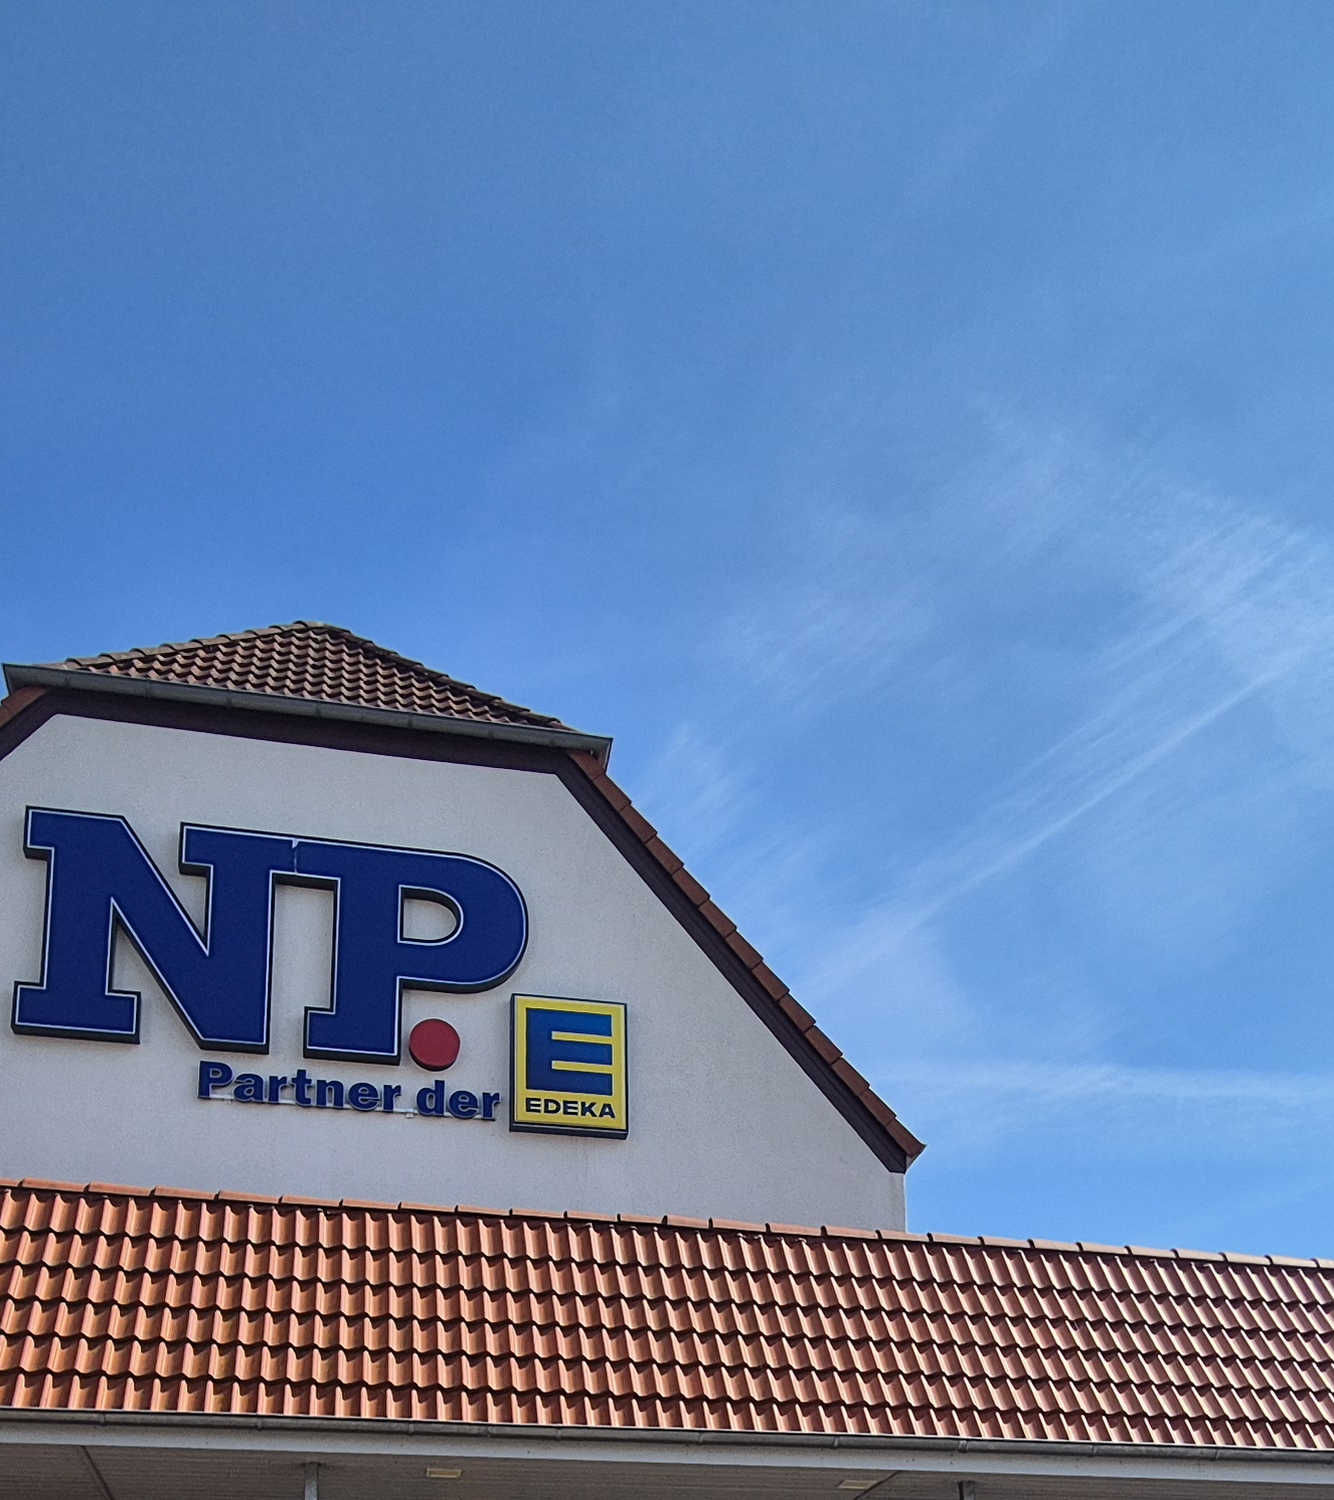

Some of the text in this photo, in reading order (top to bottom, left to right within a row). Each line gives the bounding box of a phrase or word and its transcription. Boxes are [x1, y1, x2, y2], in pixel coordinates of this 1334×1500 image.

[198, 1060, 500, 1121] Partner der
[525, 1098, 616, 1119] EDEKA
